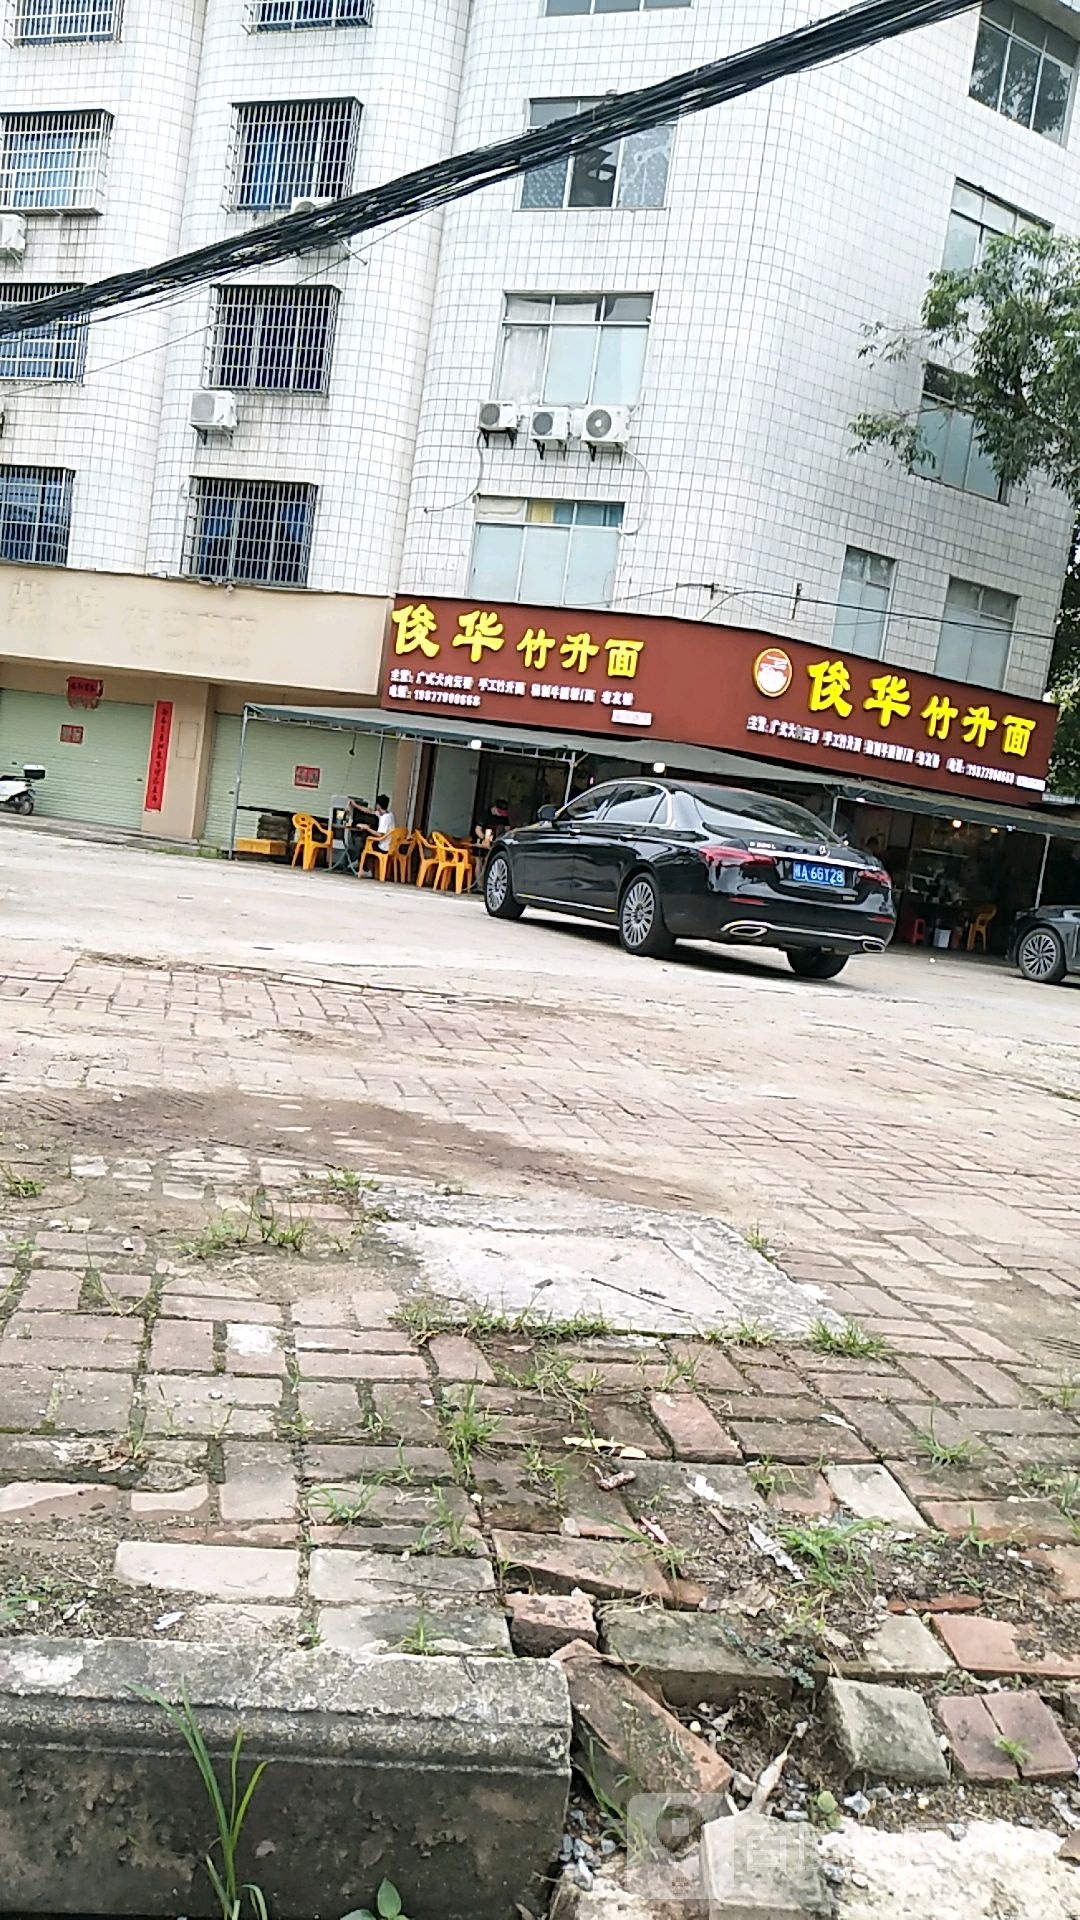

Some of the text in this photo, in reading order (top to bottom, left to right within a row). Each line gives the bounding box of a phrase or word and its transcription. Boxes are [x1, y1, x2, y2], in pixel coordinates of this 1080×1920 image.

[391, 603, 644, 678] 俊华竹升面
[807, 659, 1036, 757] 俊华竹升面
